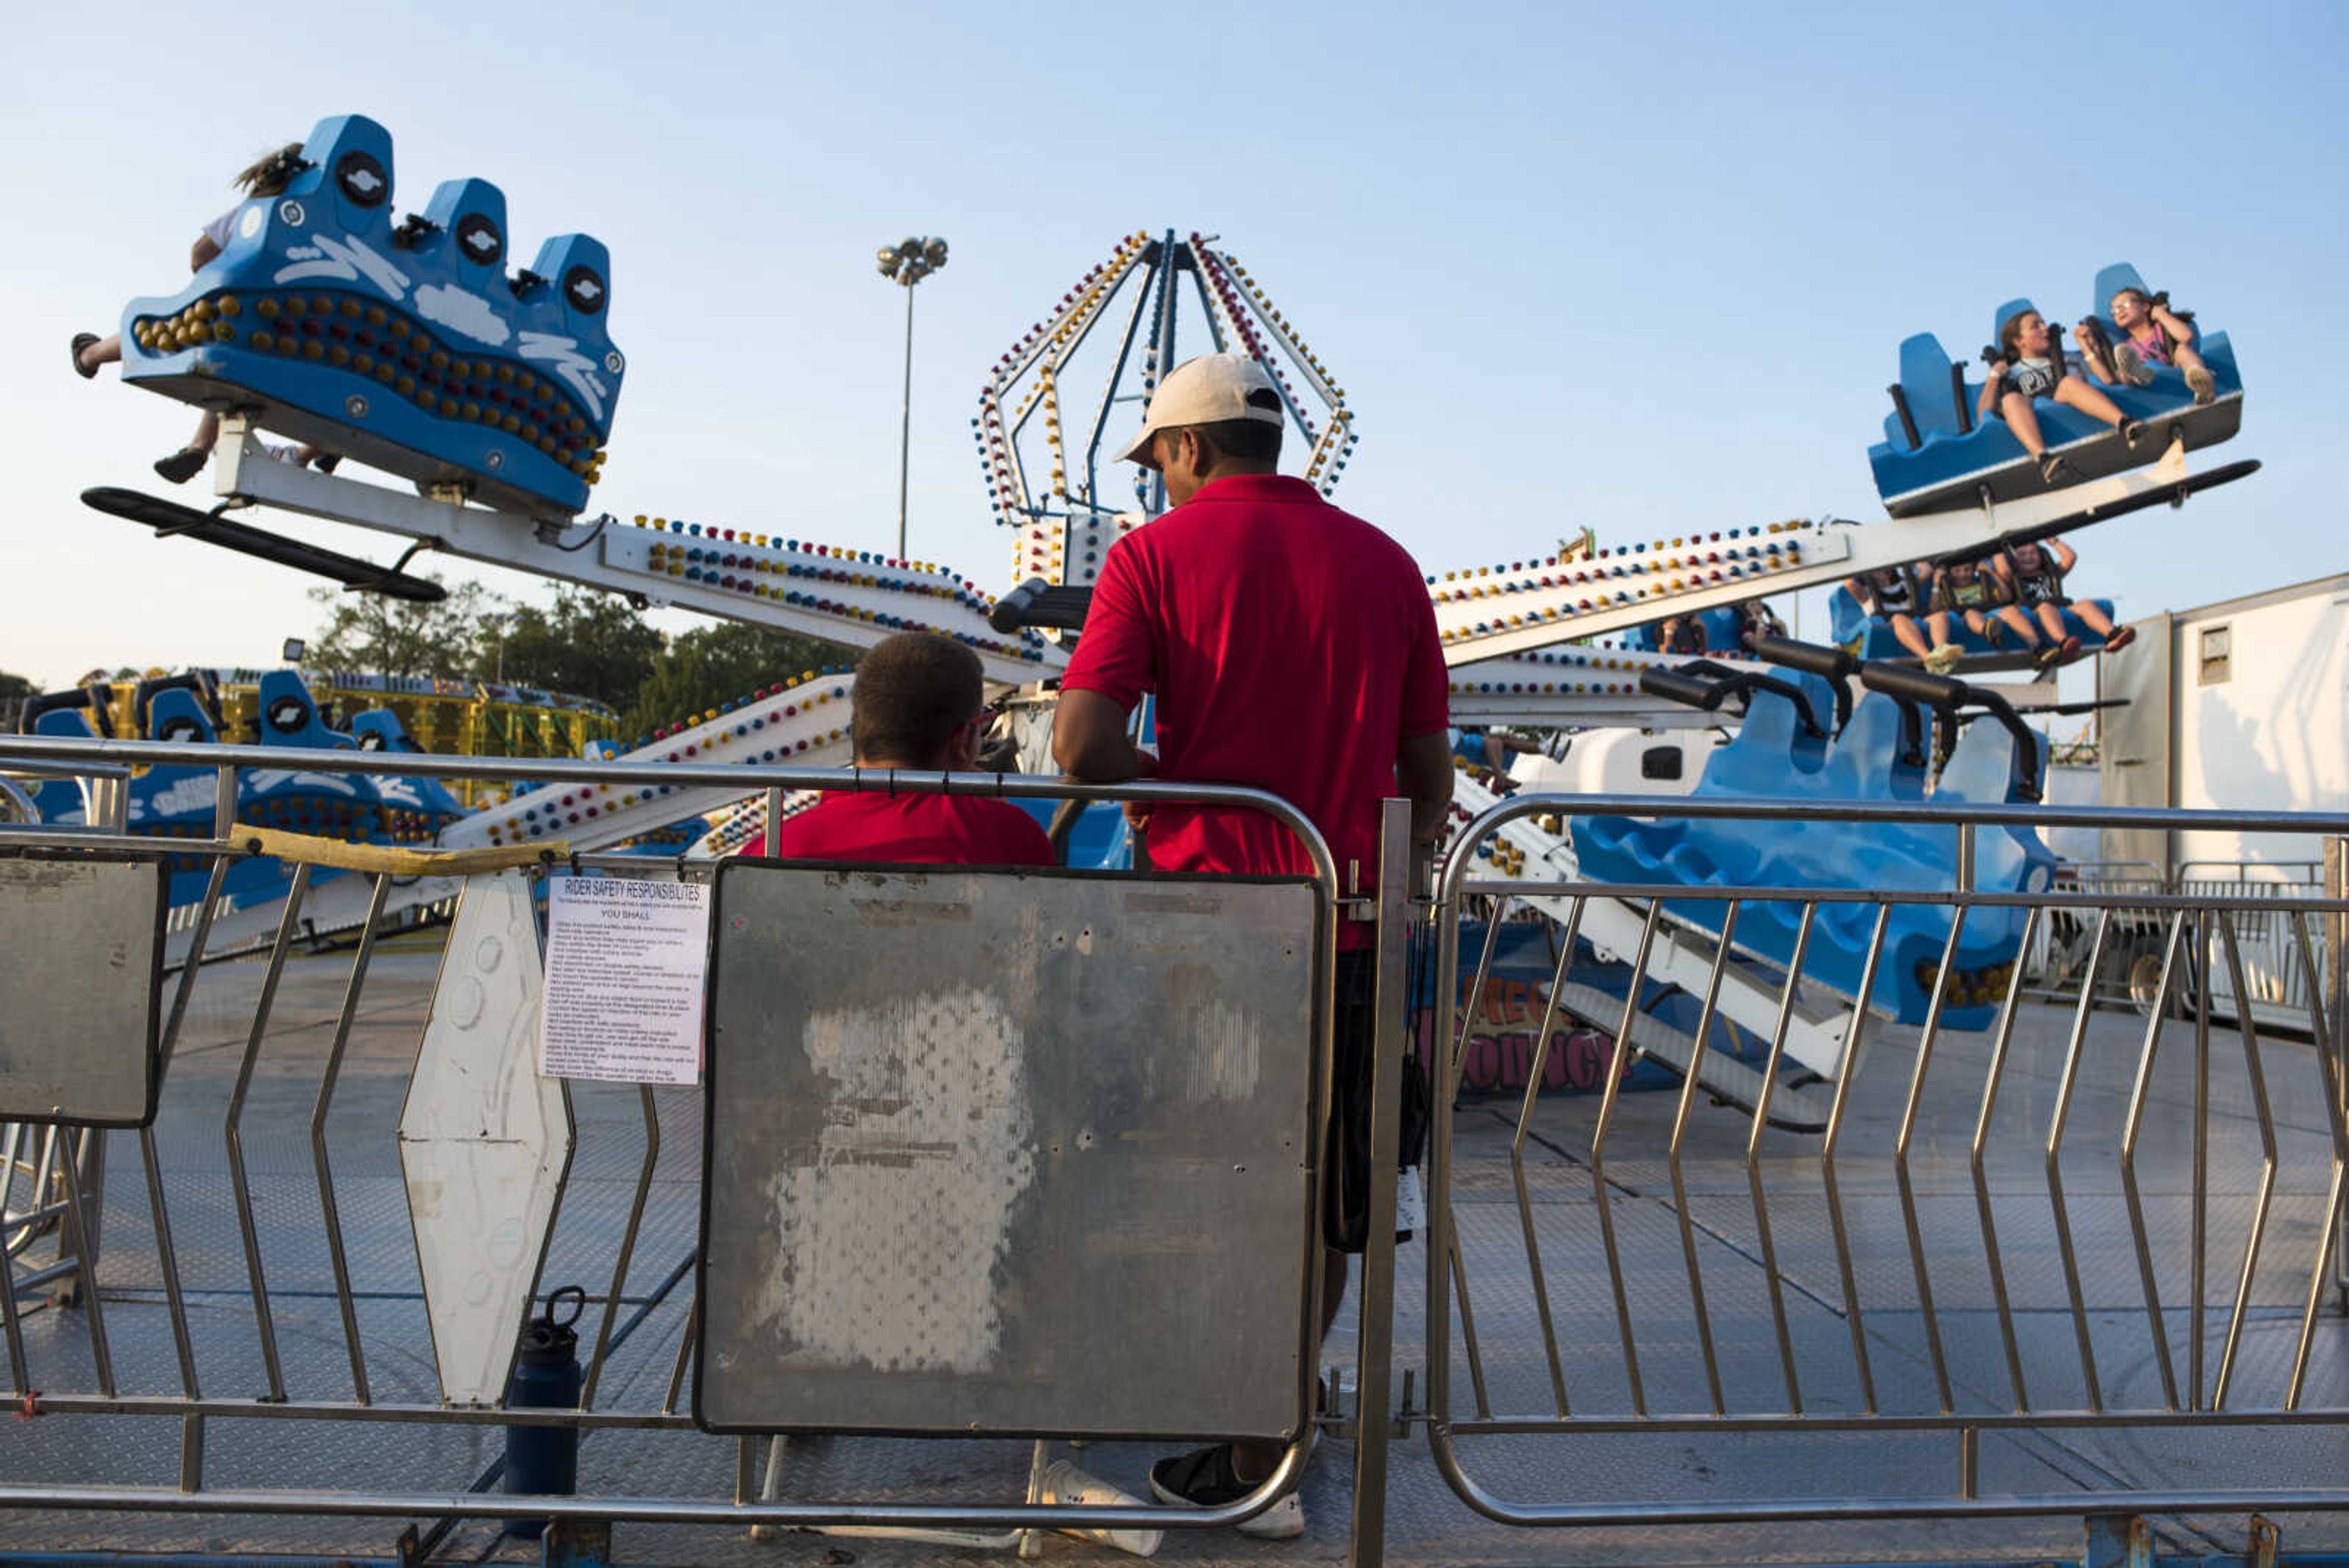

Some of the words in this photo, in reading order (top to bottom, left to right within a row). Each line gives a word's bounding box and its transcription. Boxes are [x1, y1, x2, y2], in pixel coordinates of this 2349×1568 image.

[565, 879, 591, 895] RIDER
[593, 880, 625, 897] SAFETY
[602, 910, 620, 918] YOU
[623, 910, 650, 920] SHALL
